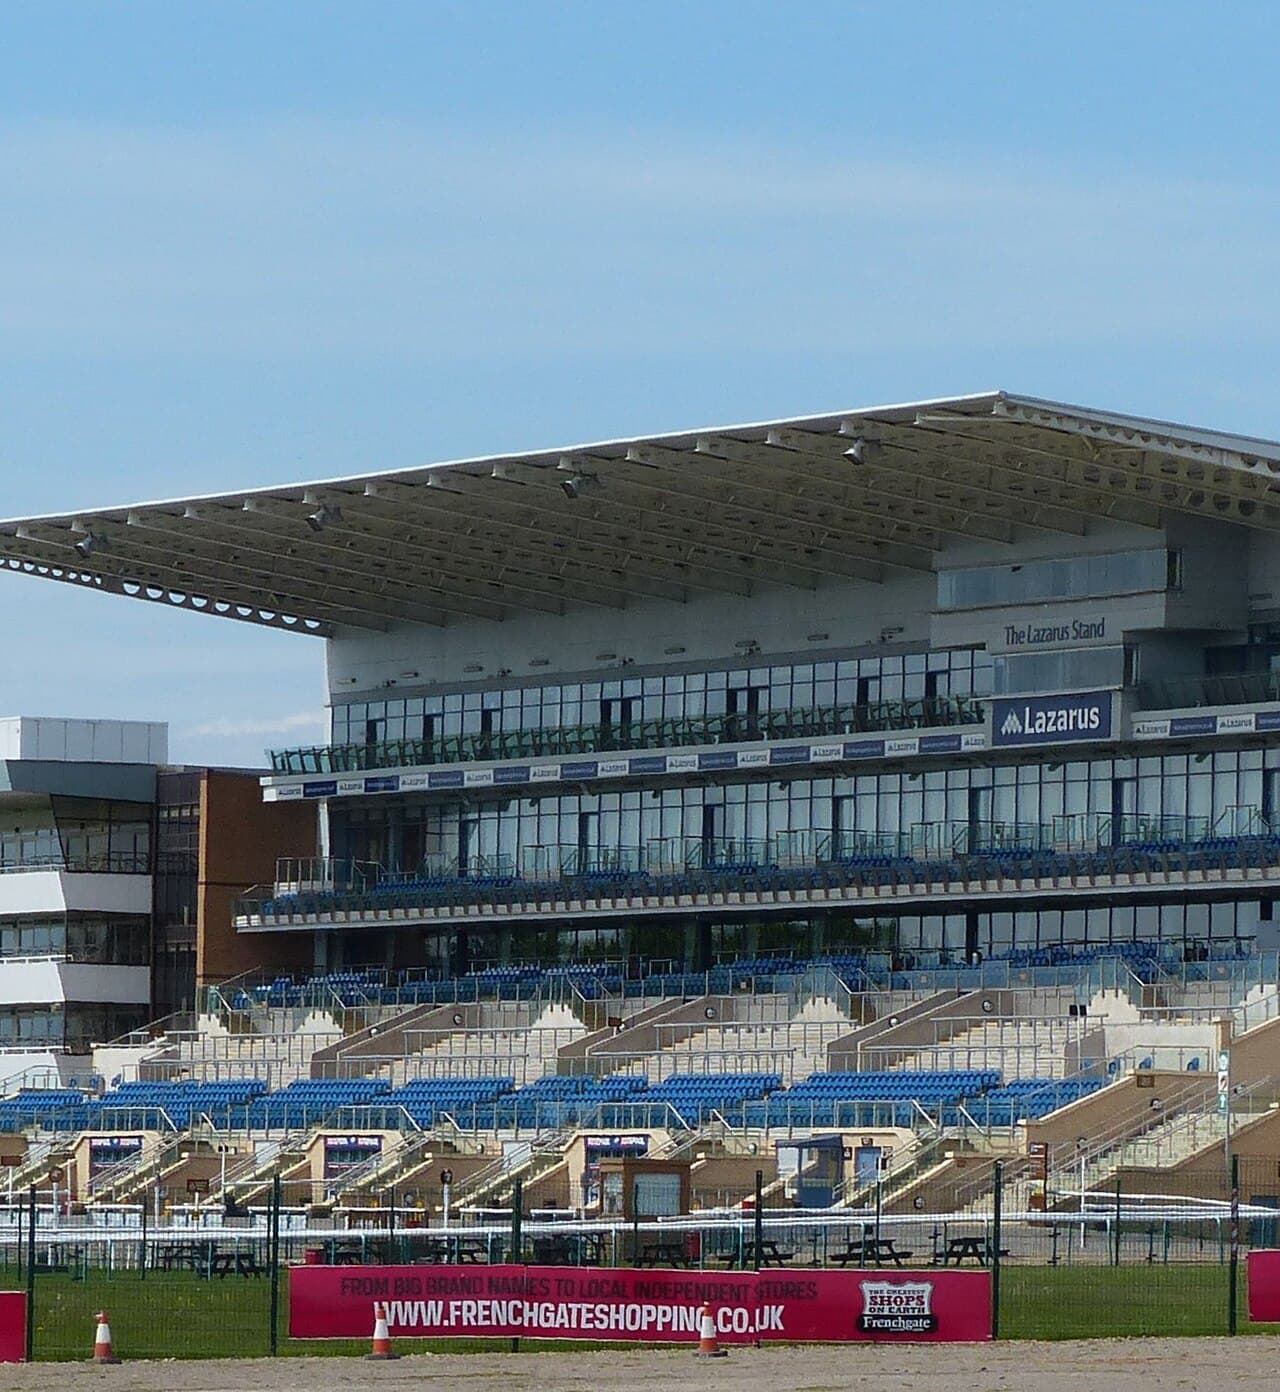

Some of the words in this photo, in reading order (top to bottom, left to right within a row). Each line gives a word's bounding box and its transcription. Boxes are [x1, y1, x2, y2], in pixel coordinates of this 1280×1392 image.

[1004, 624, 1026, 645] The
[1027, 624, 1070, 644] Lazarus
[1072, 617, 1105, 640] Stand
[1023, 706, 1100, 735] Lazarus
[341, 1278, 388, 1297] FROM
[394, 1278, 421, 1297] BIG
[426, 1278, 483, 1297] BRAND
[488, 1278, 549, 1297] NAMES
[554, 1279, 575, 1297] TO
[580, 1279, 628, 1298] LOCAL
[634, 1281, 751, 1302] INDEPENDENT
[755, 1280, 818, 1300] STORES
[869, 1295, 925, 1306] SHOPS
[863, 1316, 931, 1331] Frenchgate
